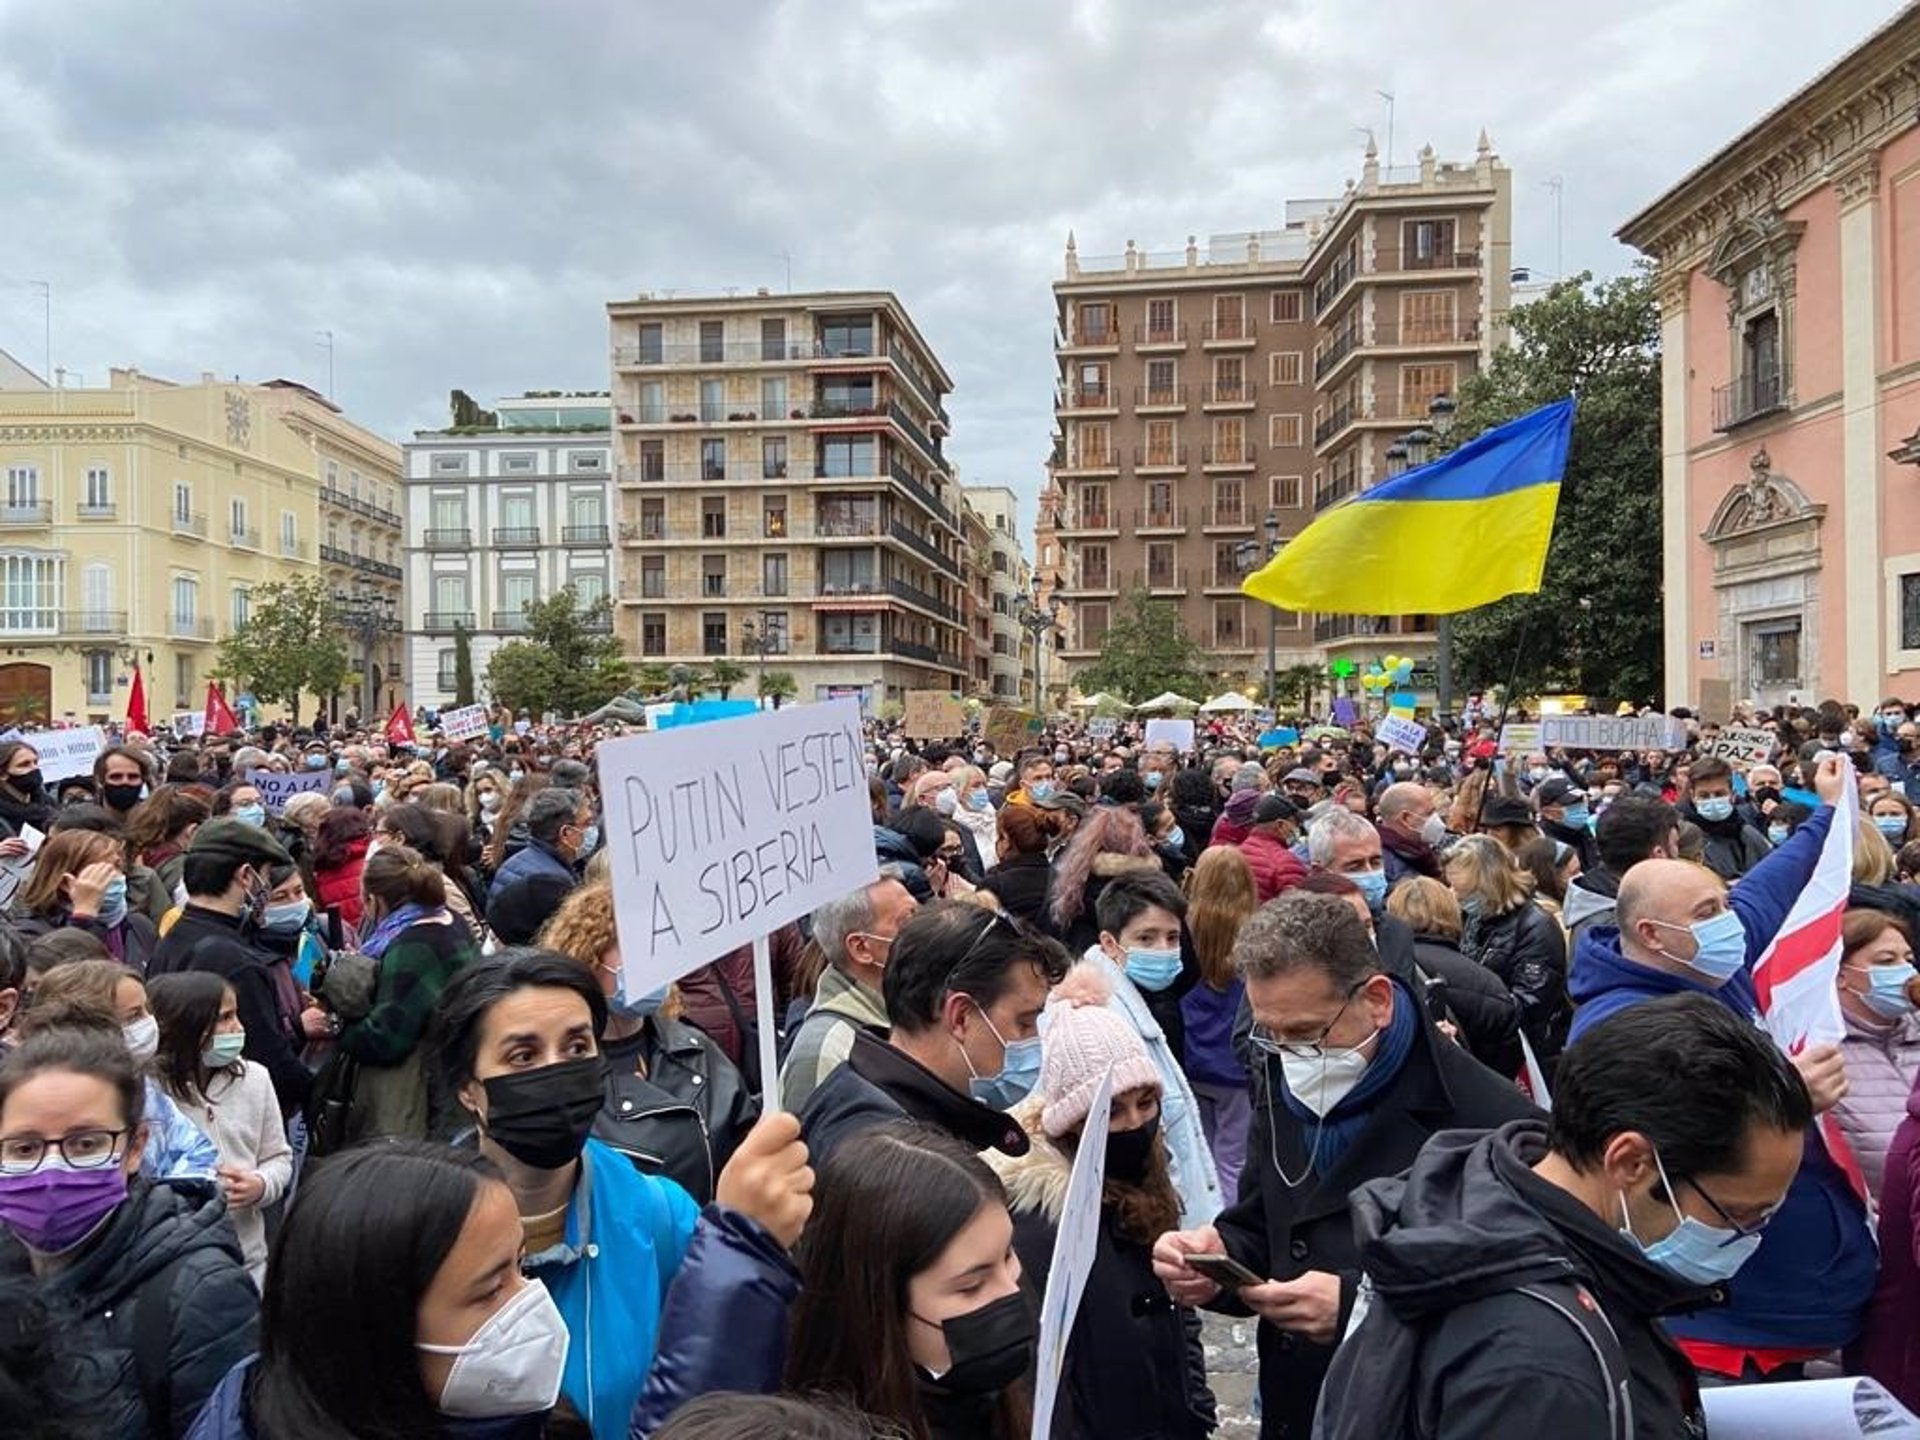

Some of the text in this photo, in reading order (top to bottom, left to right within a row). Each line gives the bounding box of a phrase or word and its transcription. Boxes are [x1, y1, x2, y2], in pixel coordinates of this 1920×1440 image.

[1601, 718, 1660, 747] ВОЙНА
[1715, 743, 1755, 763] PAZ
[254, 778, 322, 794] NO A LA
[624, 763, 747, 877] PUTIN
[759, 724, 867, 814] VESTEN
[651, 821, 832, 956] A SIBERIA
